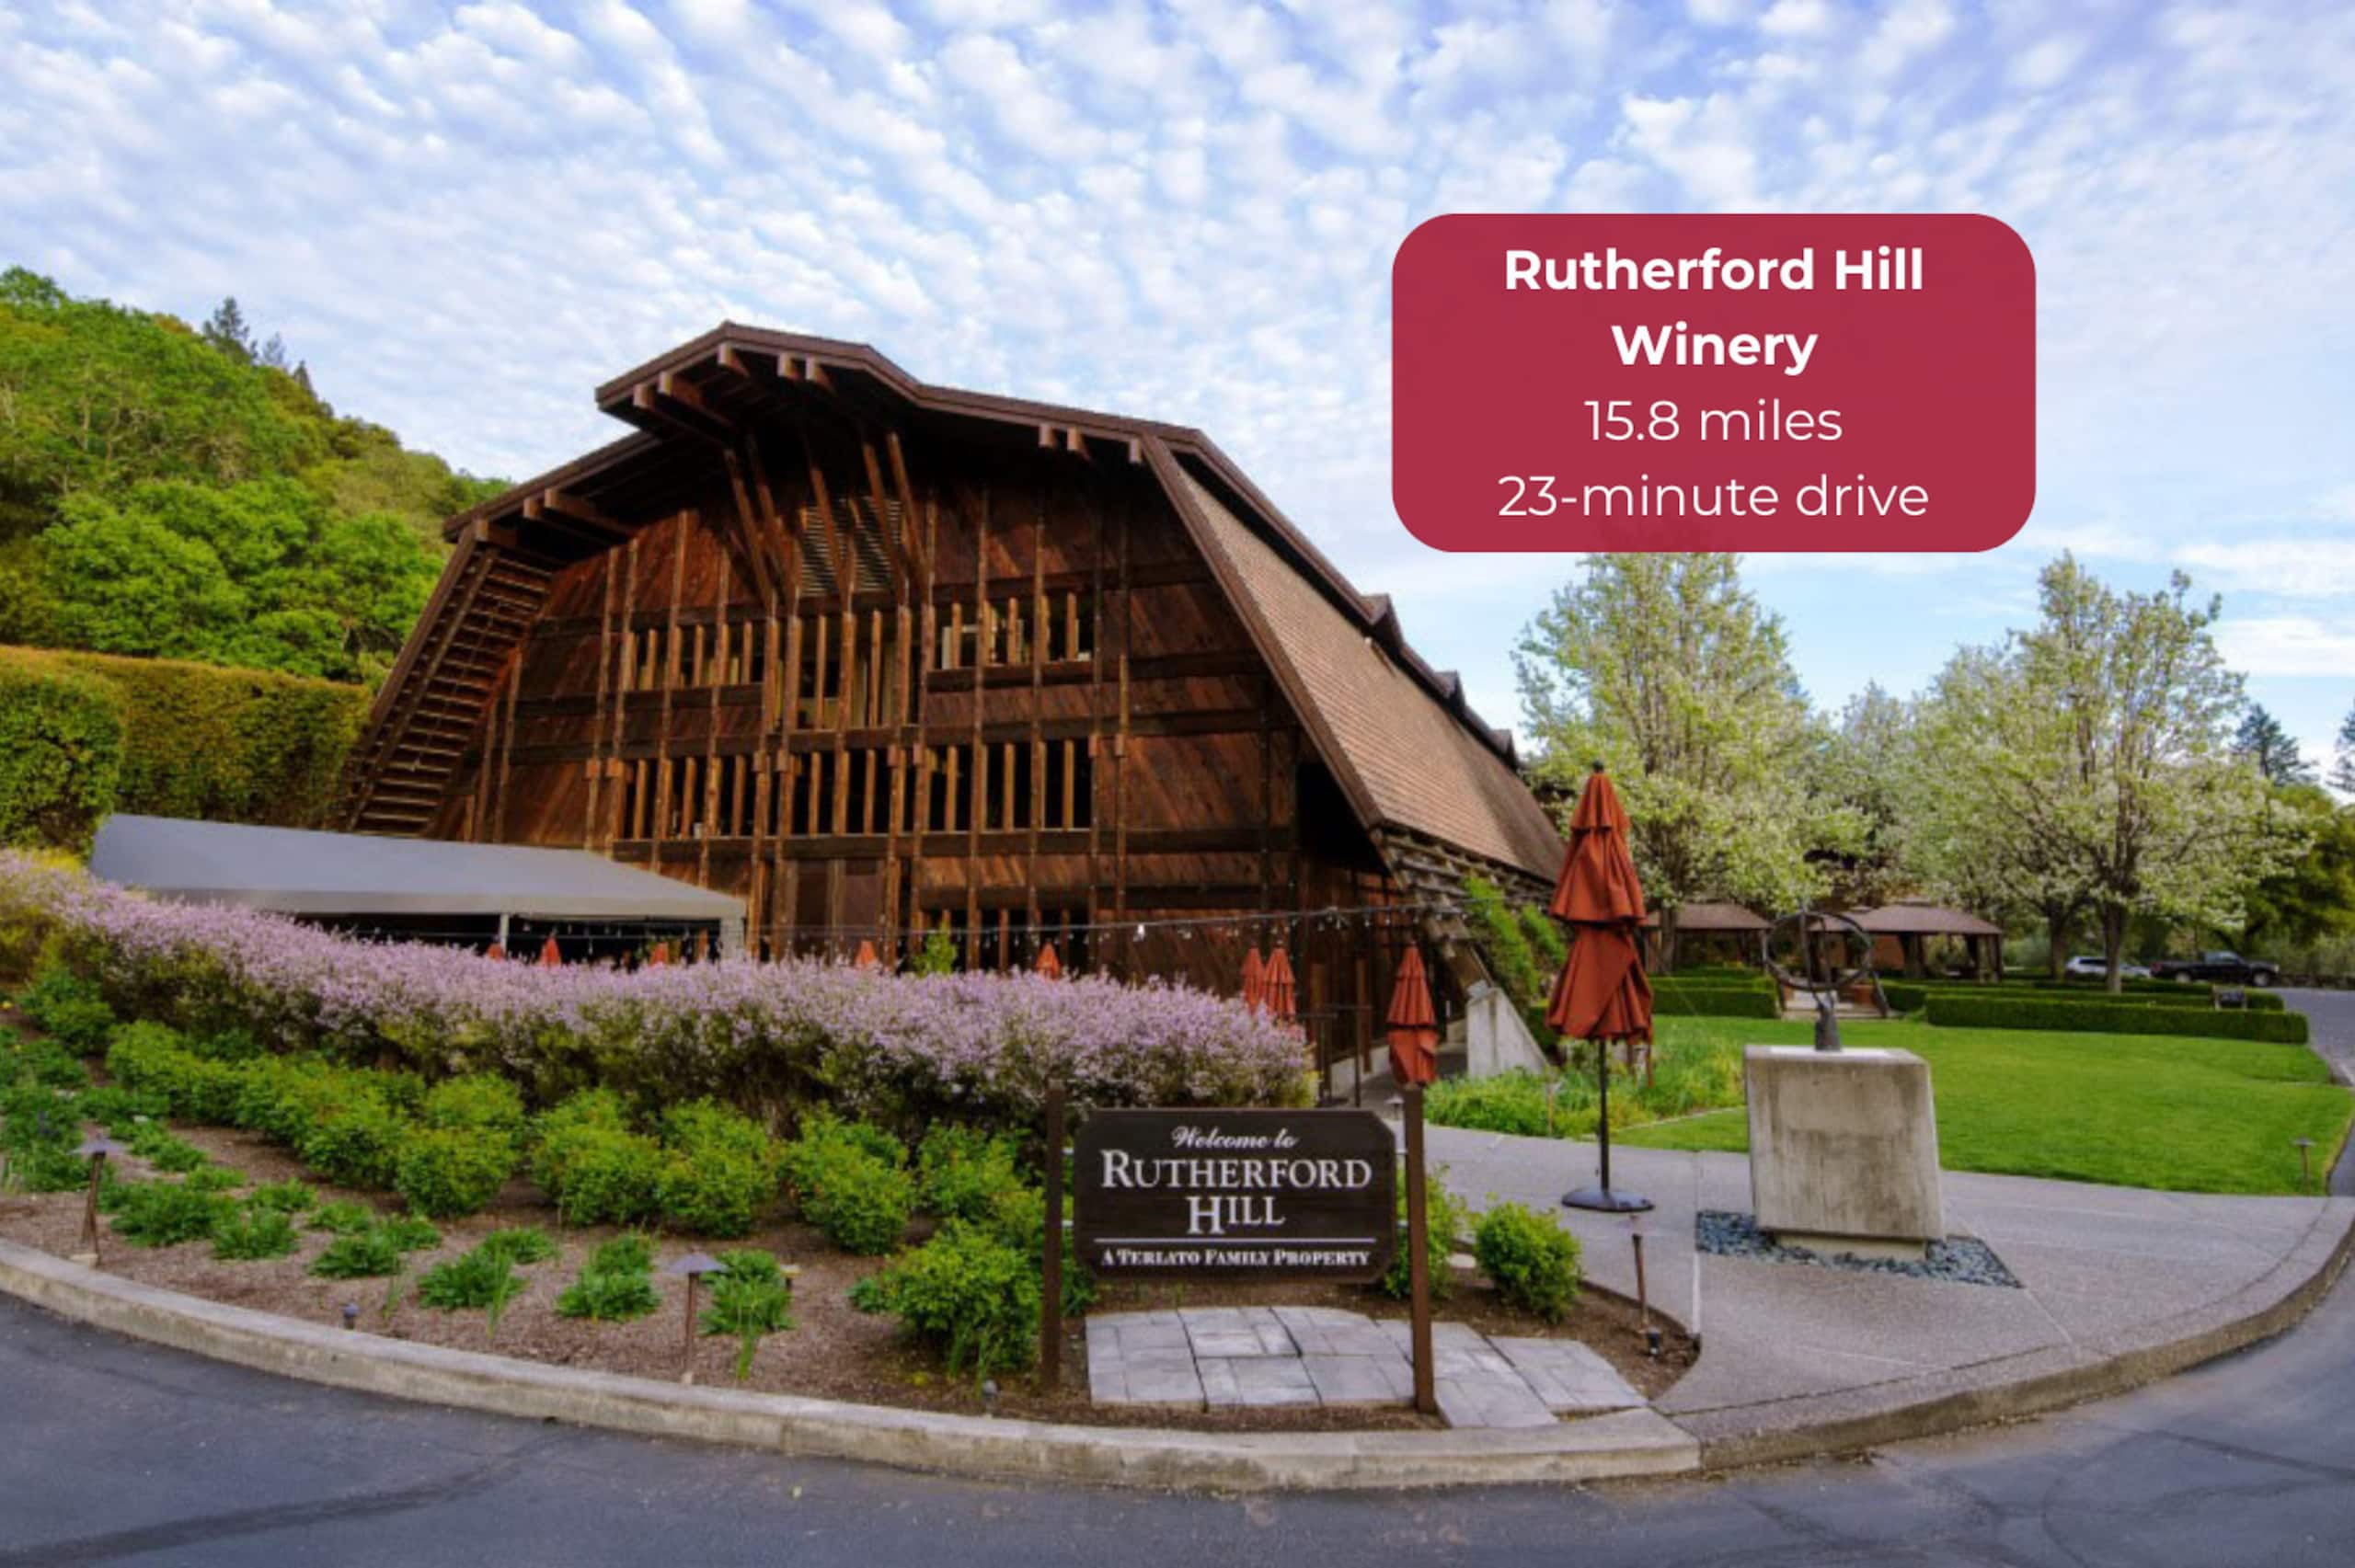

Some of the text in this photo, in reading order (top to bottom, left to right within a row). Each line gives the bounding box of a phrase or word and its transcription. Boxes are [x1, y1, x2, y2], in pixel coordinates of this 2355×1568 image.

[1171, 1126, 1299, 1150] Welcome to
[1100, 1150, 1373, 1188] RUTHERFORD
[1186, 1196, 1287, 1234] HILL
[1101, 1248, 1372, 1267] A TERLATO FAMILY PROPERTY
